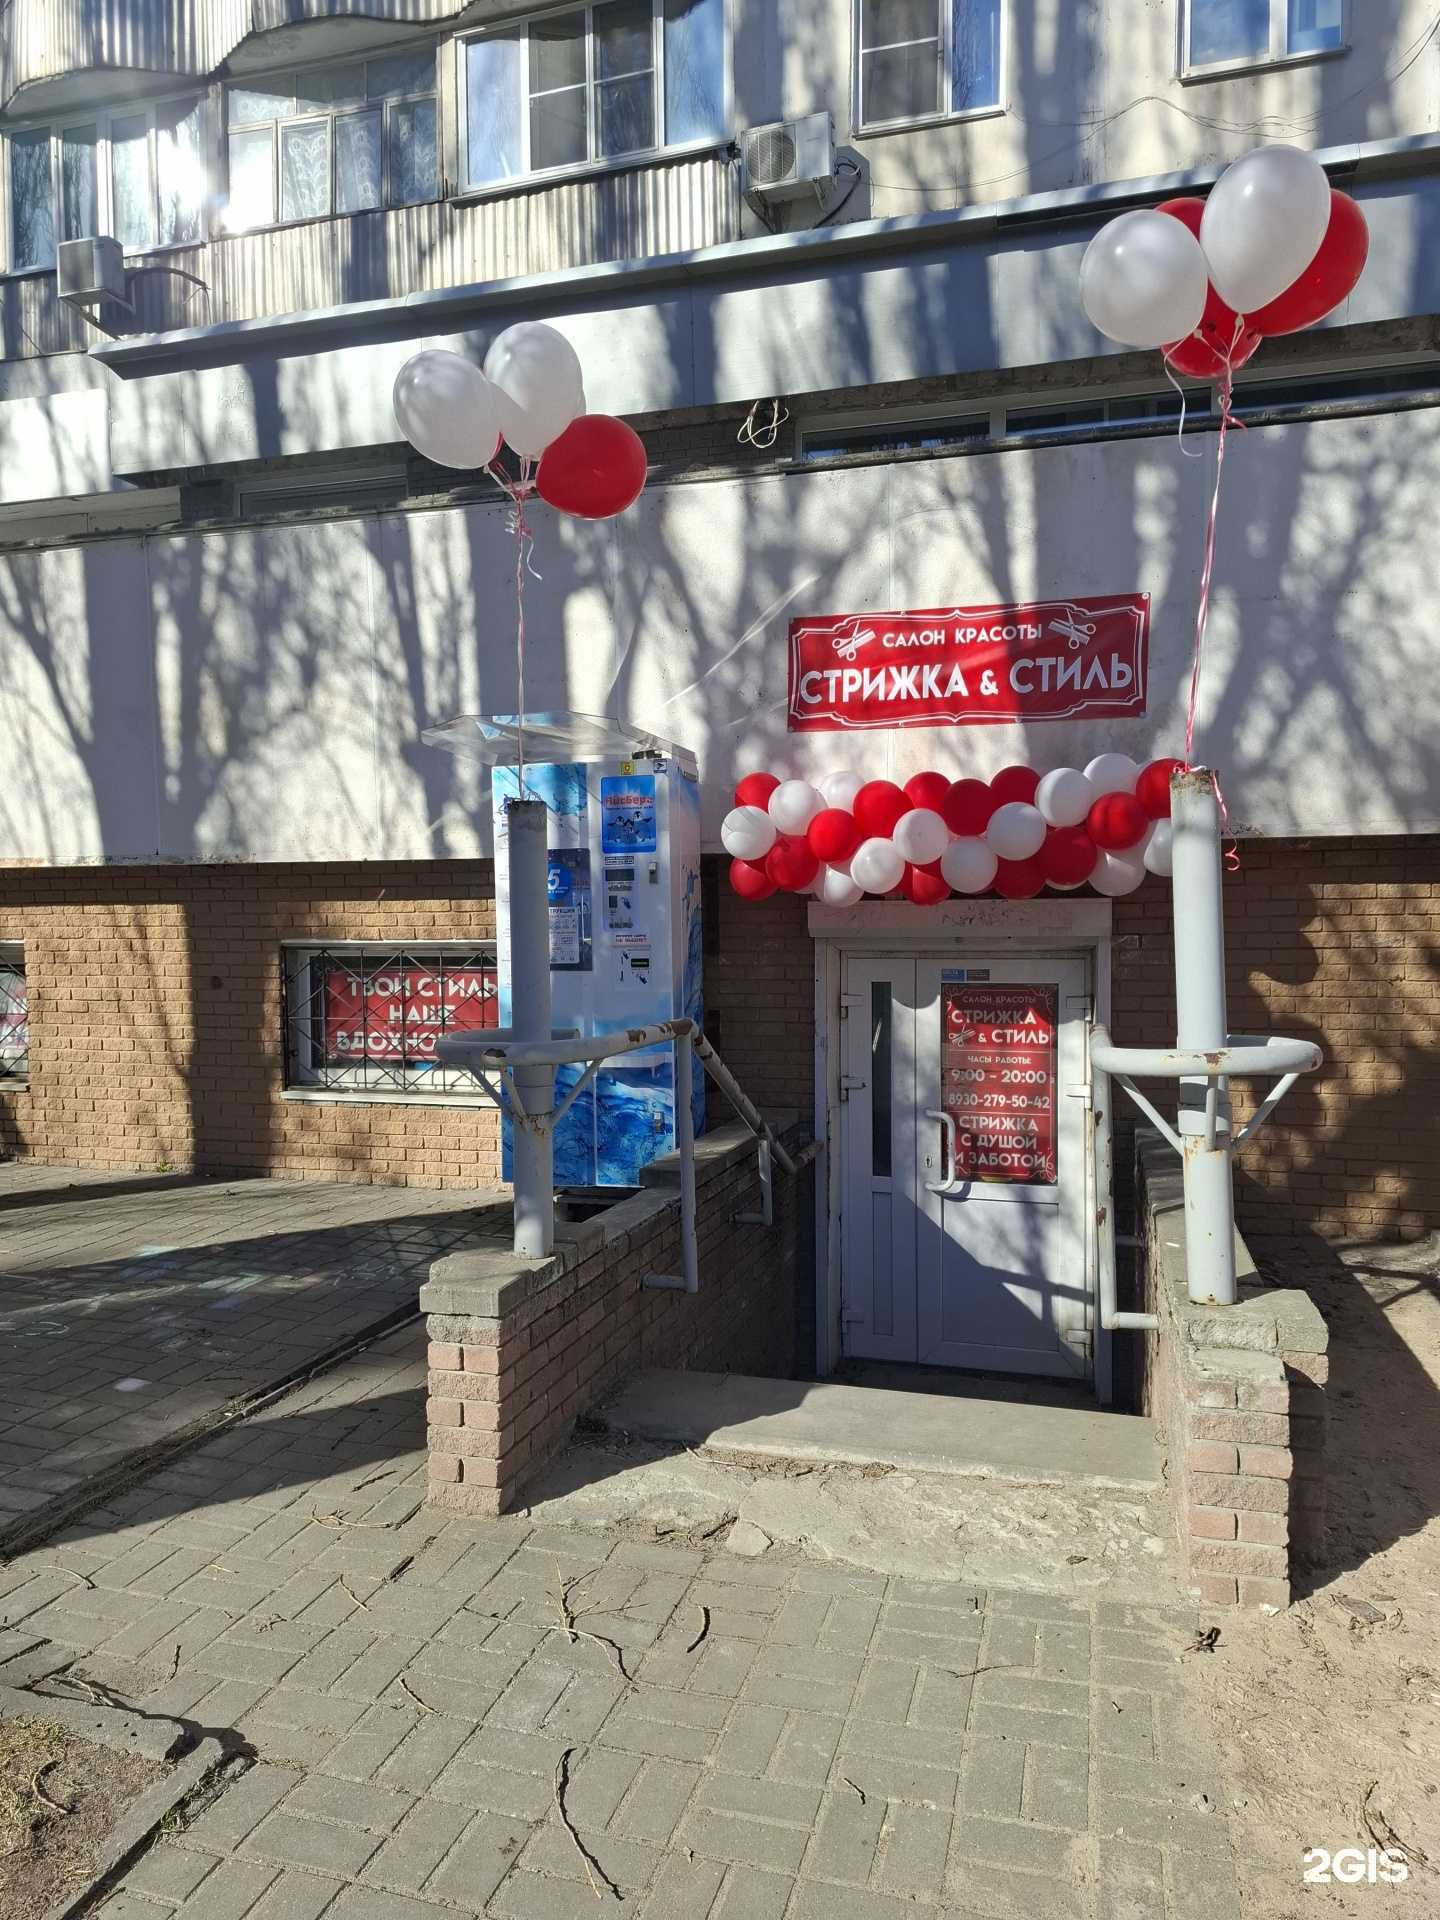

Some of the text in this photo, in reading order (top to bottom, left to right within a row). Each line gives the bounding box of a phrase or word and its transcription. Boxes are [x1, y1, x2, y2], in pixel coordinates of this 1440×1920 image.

[882, 623, 1043, 648] САЛОН КРАСОТЫ
[800, 653, 1133, 704] СТРИЖКА & СТИЛЬ
[347, 972, 498, 998] ТВОЙ СТИЛЬ
[962, 995, 1037, 1004] САЛОН КРАСОТЫ
[389, 1004, 456, 1025] НАШЕ
[951, 1009, 1037, 1025] СТРИЖКА
[336, 1031, 448, 1052] ВДОХНО
[978, 1028, 1049, 1044] & СТИЛЬ
[968, 1055, 992, 1064] ЧАСЫ
[951, 1069, 986, 1082] 9:00
[1001, 1069, 1047, 1084] 20:00
[948, 1093, 1050, 1109] 8930-279-50-42
[959, 1115, 1039, 1132] СТРИЖКА
[961, 1132, 1037, 1150] С ДУШОЙ
[954, 1151, 1046, 1168] И ЗАБОТОЙ
